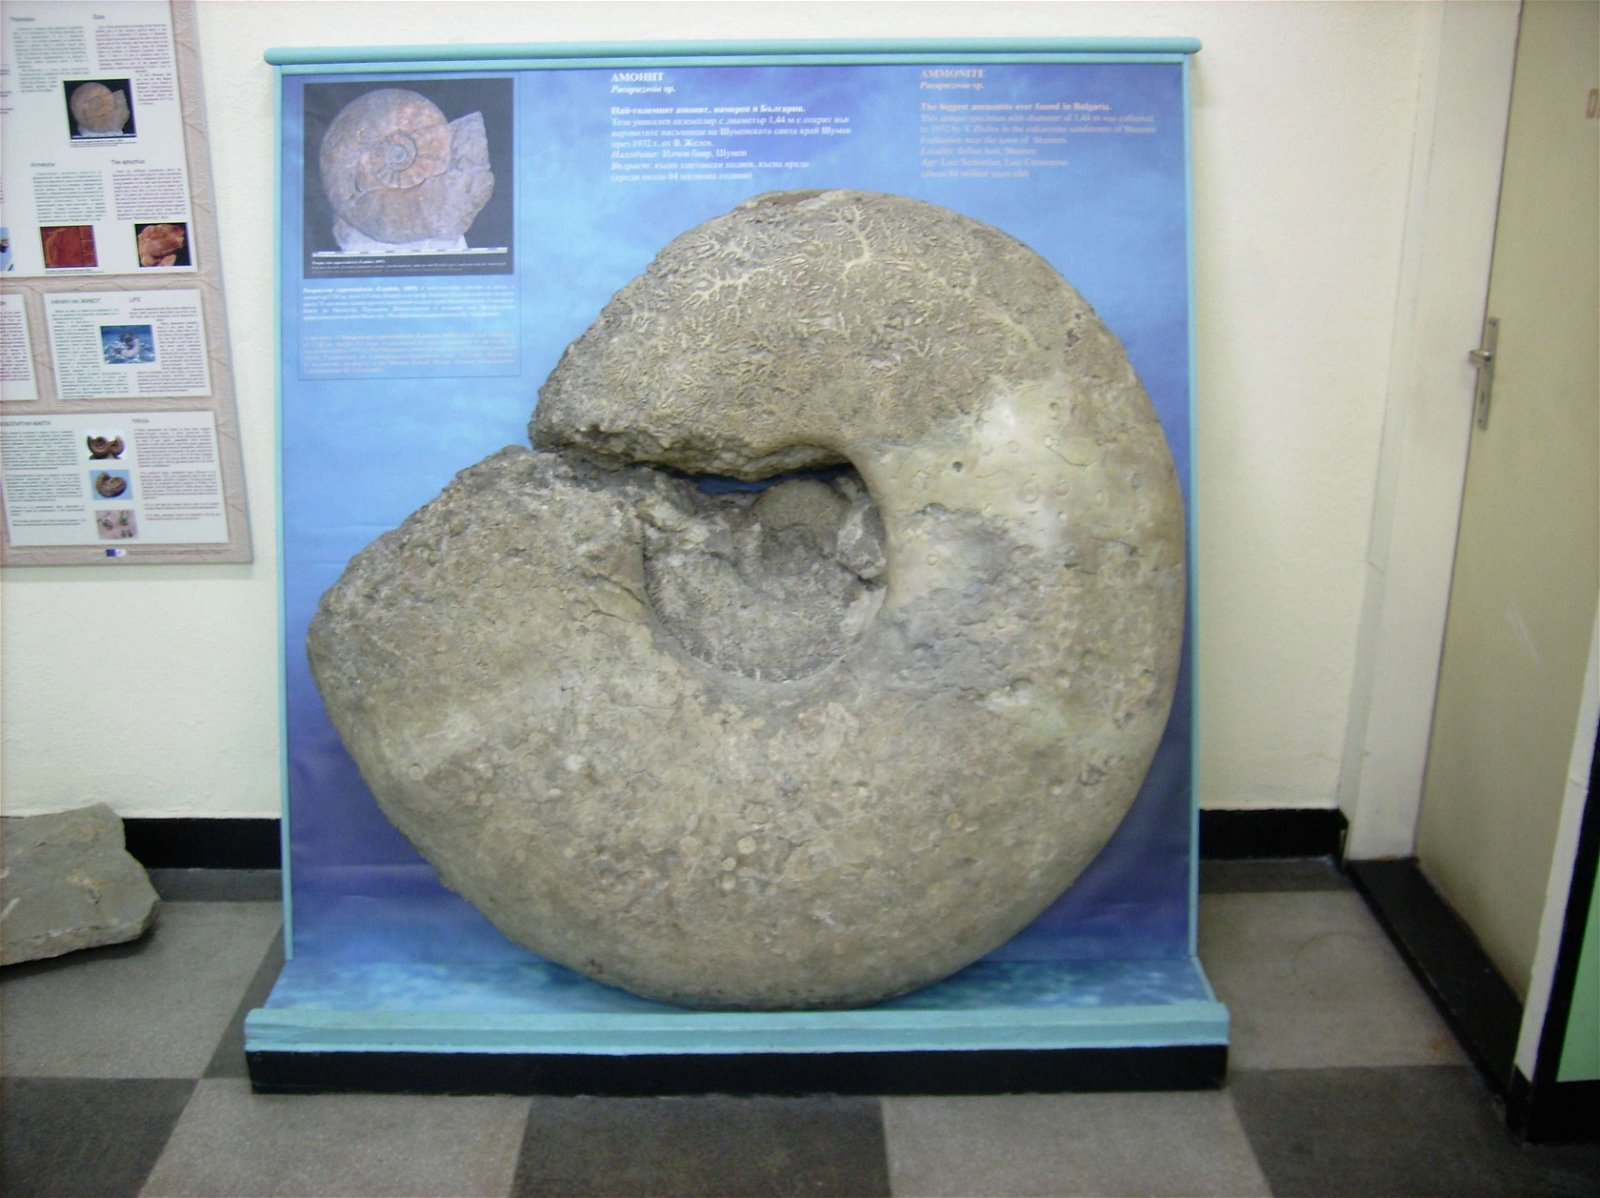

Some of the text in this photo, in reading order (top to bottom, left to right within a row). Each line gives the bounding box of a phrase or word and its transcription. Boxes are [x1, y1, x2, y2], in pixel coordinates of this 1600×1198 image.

[611, 72, 664, 82] АМОНИТ
[919, 69, 986, 79] AMMONITE
[920, 102, 937, 111] The
[1034, 102, 1061, 111] found
